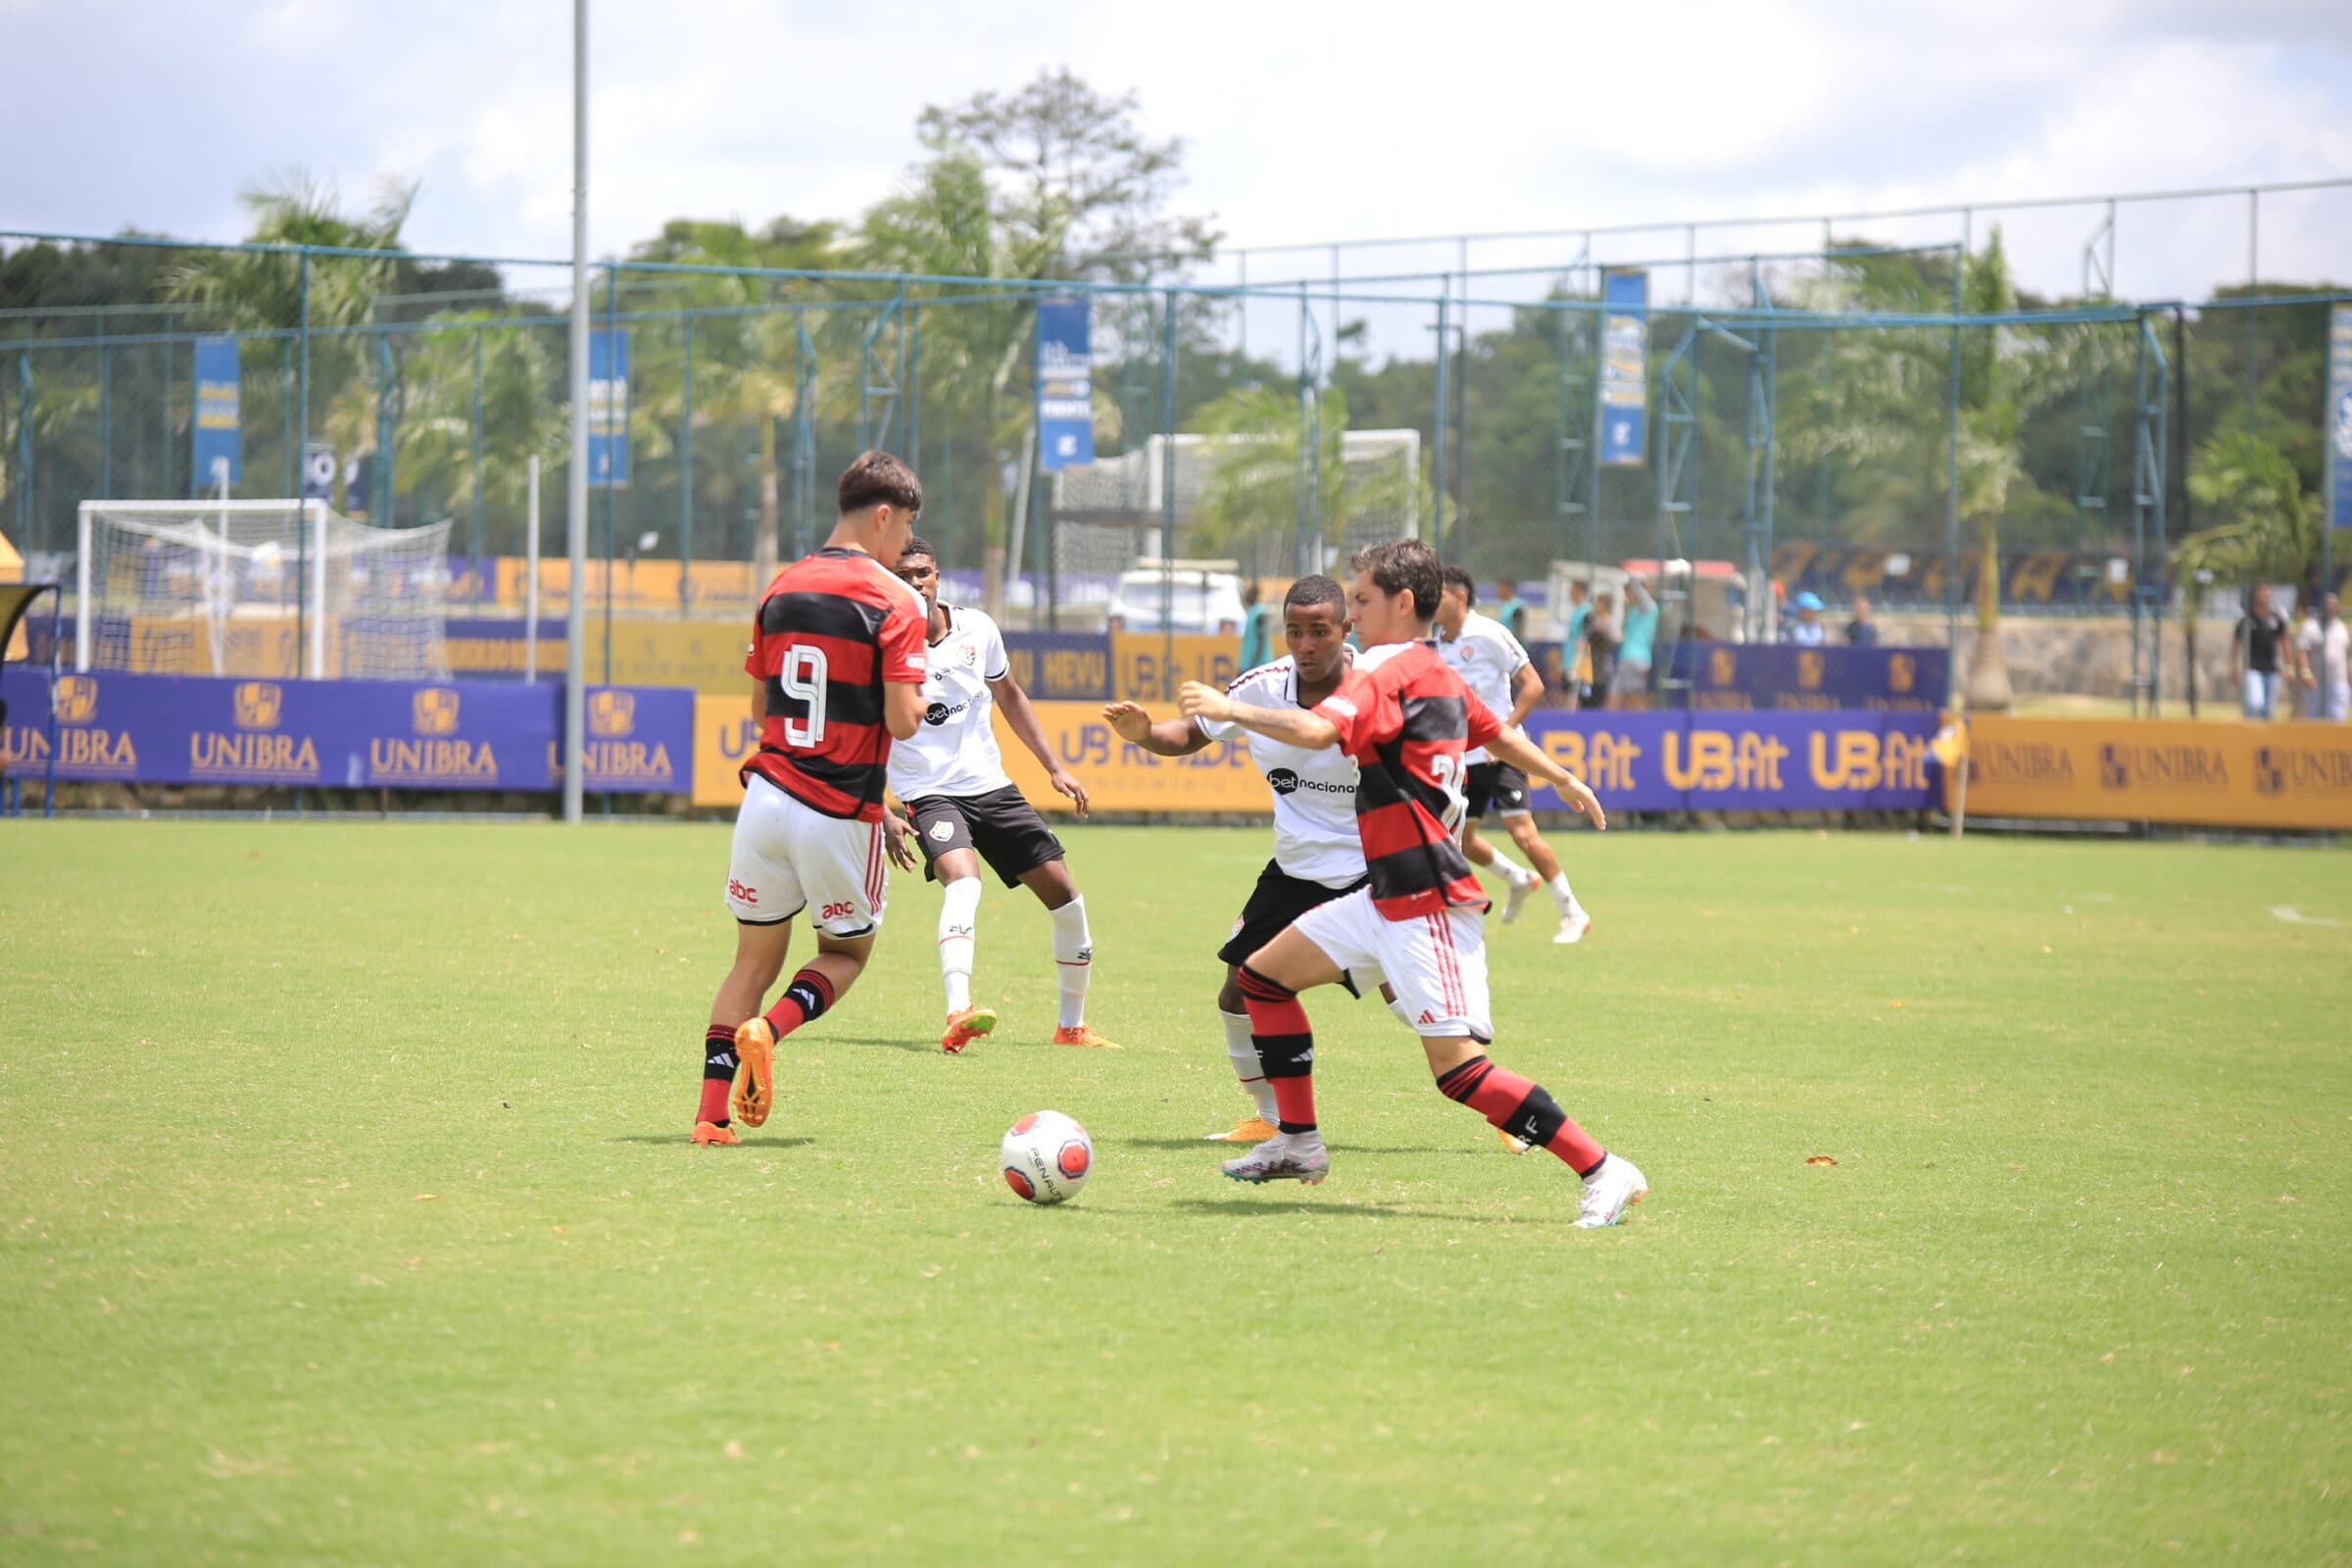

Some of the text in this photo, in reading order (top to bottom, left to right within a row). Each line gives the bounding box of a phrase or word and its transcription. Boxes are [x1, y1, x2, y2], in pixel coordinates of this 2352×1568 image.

[781, 644, 827, 749] 9
[190, 732, 318, 770] UNIBRA
[370, 738, 497, 774] UNIBRA
[2133, 745, 2229, 782] UNIBRA
[1299, 779, 1355, 793] naciona
[729, 879, 759, 903] abc
[1030, 1147, 1063, 1203] PENALT
